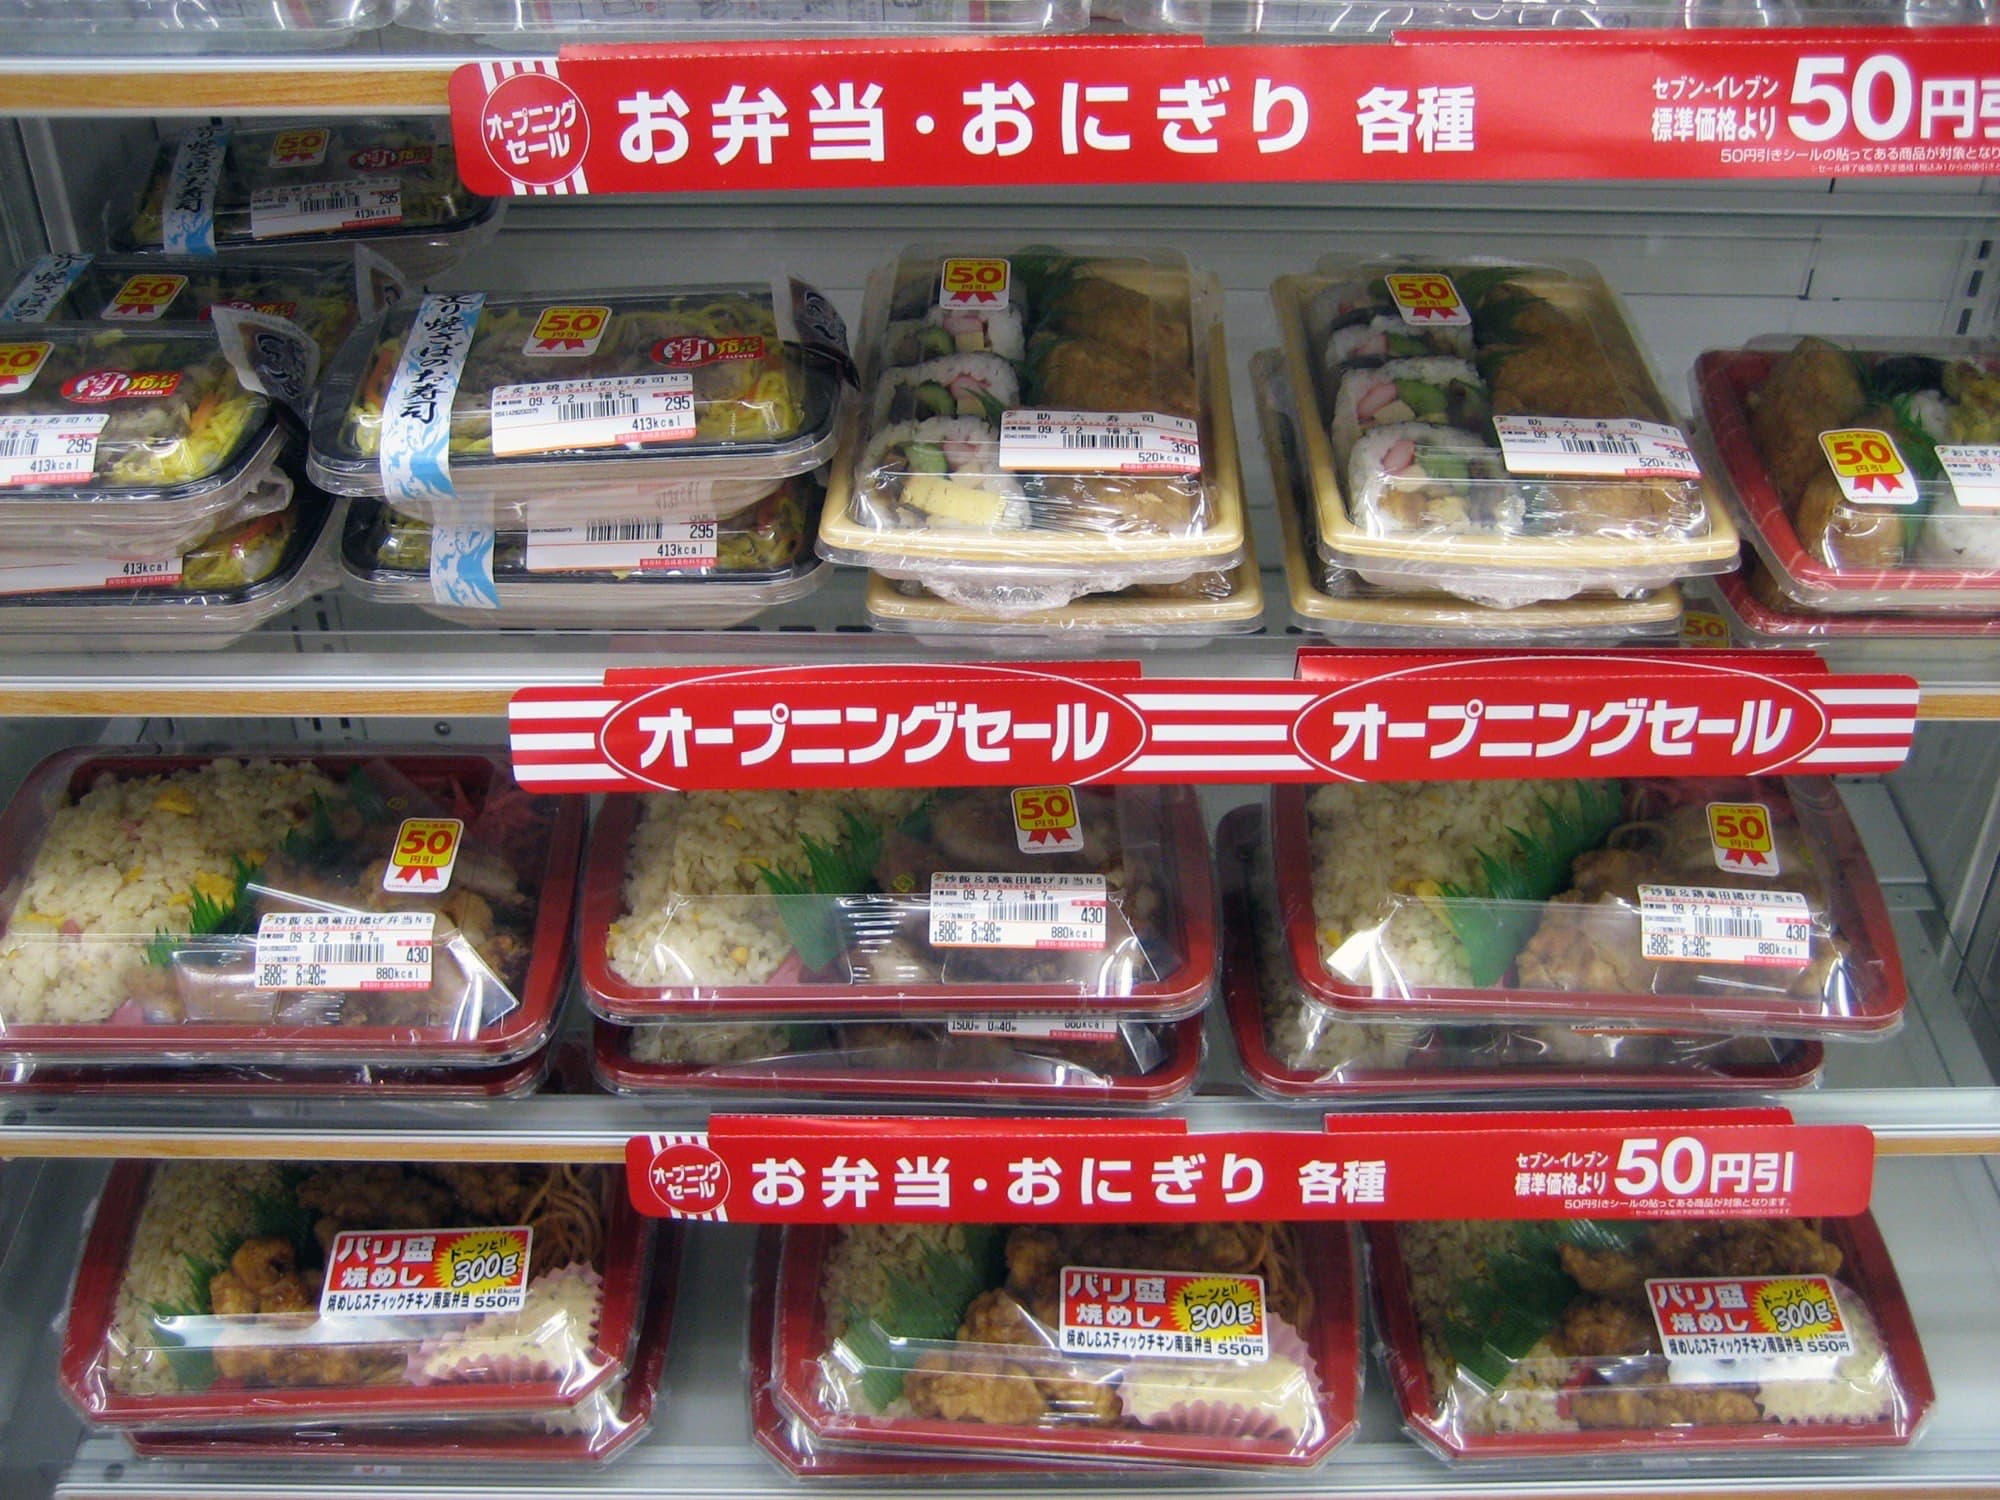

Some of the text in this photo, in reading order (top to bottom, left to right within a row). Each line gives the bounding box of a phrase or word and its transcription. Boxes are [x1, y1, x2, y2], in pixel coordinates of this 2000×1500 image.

[1652, 75, 1779, 101] セブン-イレブン
[486, 98, 577, 142] オープニング
[617, 77, 1475, 165] お弁当・おにぎり 各種
[1651, 105, 1776, 143] 標準価格より
[278, 134, 323, 150] 50
[505, 130, 571, 165] セール
[379, 193, 399, 205] 295
[949, 267, 1002, 284] 50
[123, 281, 175, 298] 50
[1398, 282, 1450, 300] 50
[541, 314, 601, 332] 50
[0, 350, 40, 367] 0
[665, 397, 691, 412] 295
[632, 416, 682, 431] 413kcal
[66, 438, 94, 454] 295
[1171, 441, 1197, 456] 390
[1667, 447, 1692, 461] 390
[1833, 439, 1892, 466] 50
[30, 458, 80, 473] 413kcal
[1138, 452, 1187, 464] 520kcal
[1638, 457, 1687, 469] 520kcal
[689, 524, 714, 539] 295
[657, 543, 703, 557] 413kcal
[122, 563, 170, 575] 413kcal
[1683, 618, 1726, 638] 50
[638, 701, 1110, 769] オープニングセール
[1329, 697, 1792, 762] オープニングセール
[1021, 794, 1070, 820] 50
[1034, 818, 1059, 828] 円引
[1716, 814, 1765, 841] 50
[400, 830, 453, 855] 50
[1729, 839, 1755, 849] 円引
[410, 855, 434, 865] 円引
[1081, 906, 1103, 924] 430
[1051, 926, 1093, 939] 880kcal
[1785, 924, 1807, 941] 430
[406, 946, 429, 963] 430
[1758, 942, 1799, 955] 880kcal
[376, 967, 419, 980] 880kcal
[1515, 1151, 1609, 1169] セブン-イレブン
[1614, 1136, 1794, 1196] 50円引
[652, 1160, 721, 1185] オープニング
[750, 1153, 1387, 1208] お弁当・おにぎり 各種
[666, 1181, 716, 1200] セール
[1514, 1170, 1606, 1197] 標準価格より
[337, 1235, 437, 1265] バリ盛
[340, 1266, 425, 1289] 焼めし
[450, 1251, 521, 1289] 300g
[1067, 1272, 1167, 1304] バリ盛
[1656, 1283, 1749, 1311] バリ盛
[474, 1295, 520, 1308] 550円
[1075, 1303, 1161, 1329] 焼めし
[1189, 1299, 1256, 1333] 300g
[1670, 1312, 1749, 1333] 焼めし
[1771, 1298, 1833, 1334] 300g
[1217, 1343, 1264, 1356] 550円
[1806, 1340, 1851, 1353] 550円
